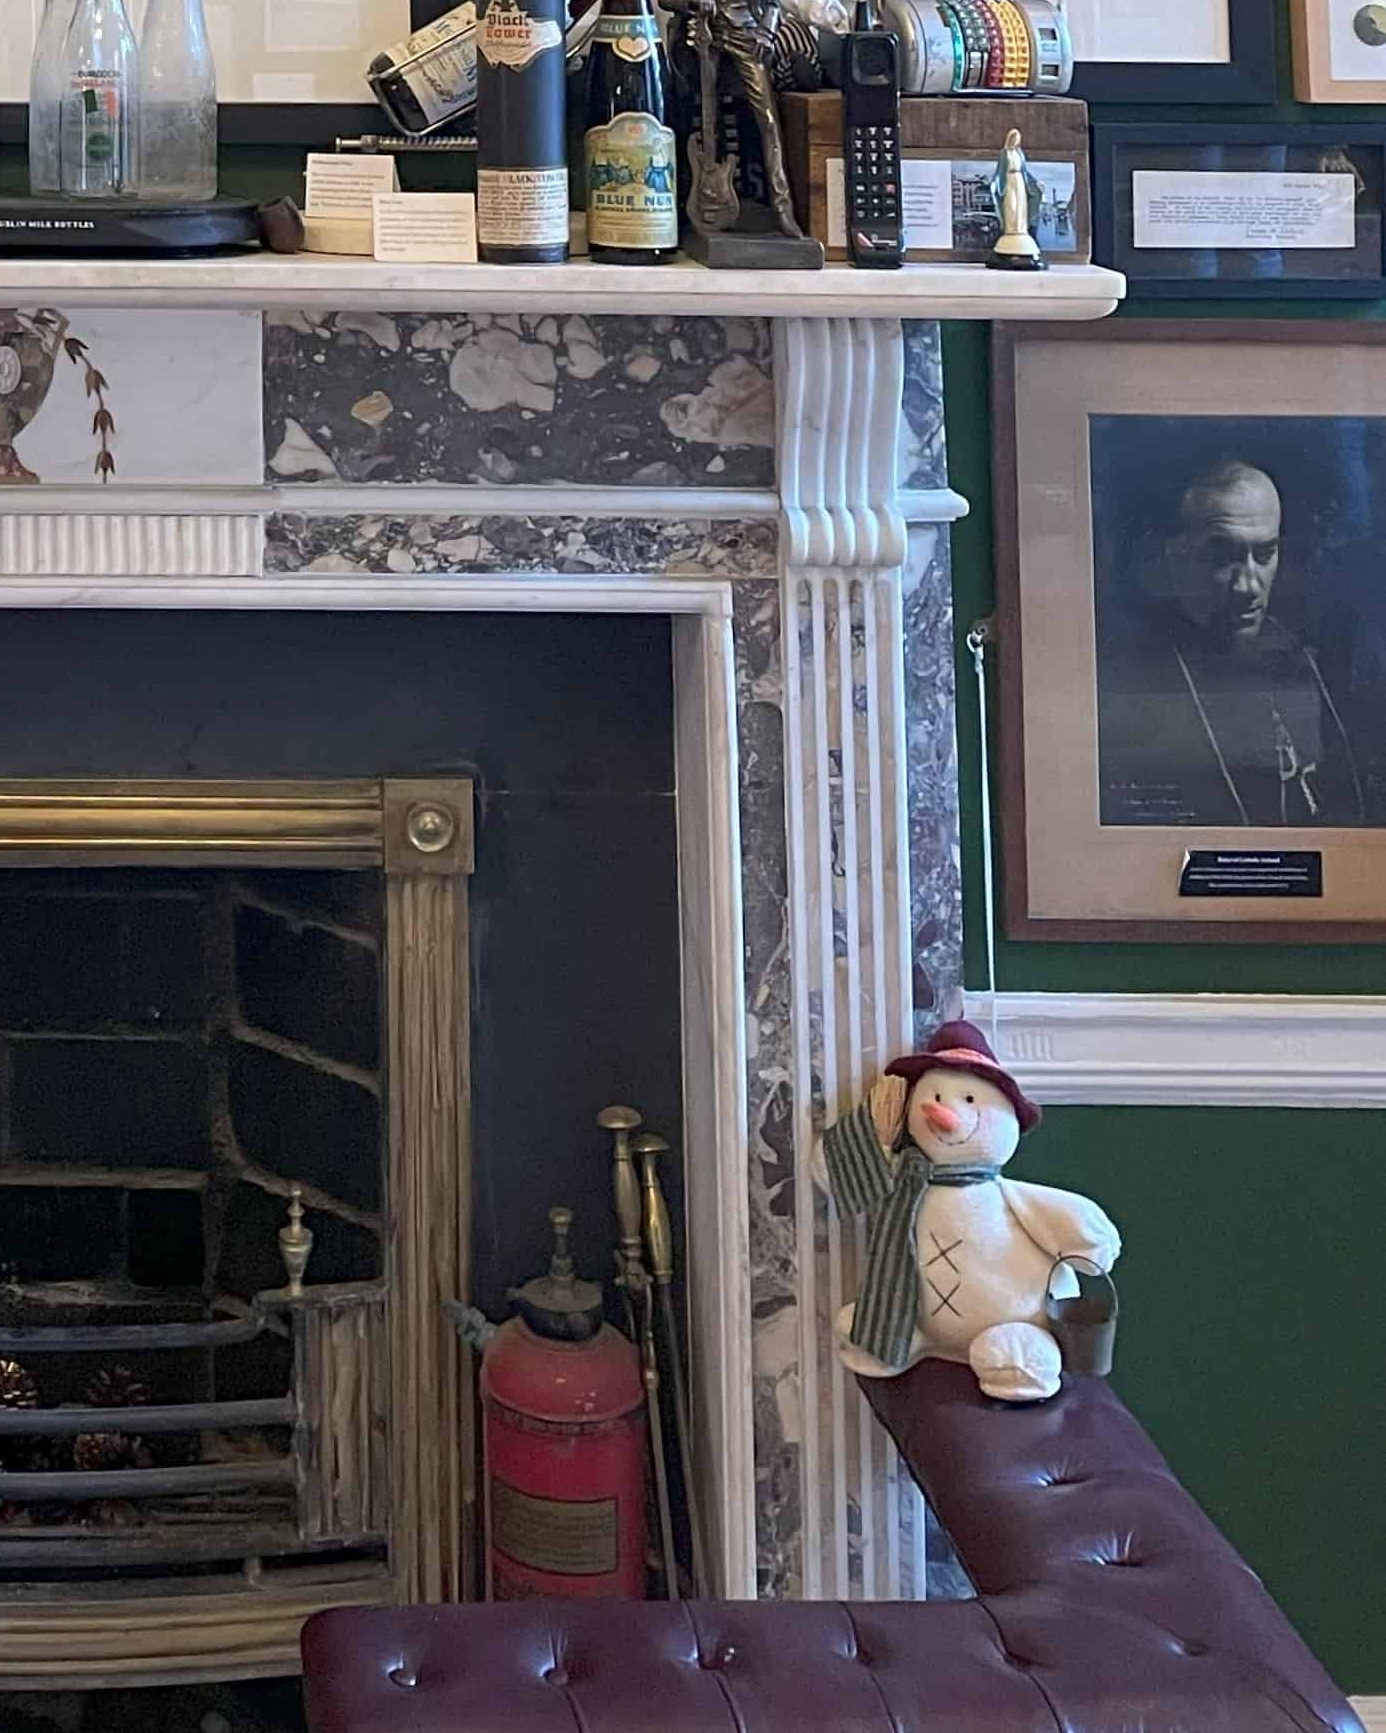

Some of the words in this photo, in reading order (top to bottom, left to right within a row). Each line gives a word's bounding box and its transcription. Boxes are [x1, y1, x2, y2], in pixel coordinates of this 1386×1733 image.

[597, 194, 635, 205] BLUE
[29, 220, 52, 228] MILK
[54, 220, 95, 229] BOTTLES
